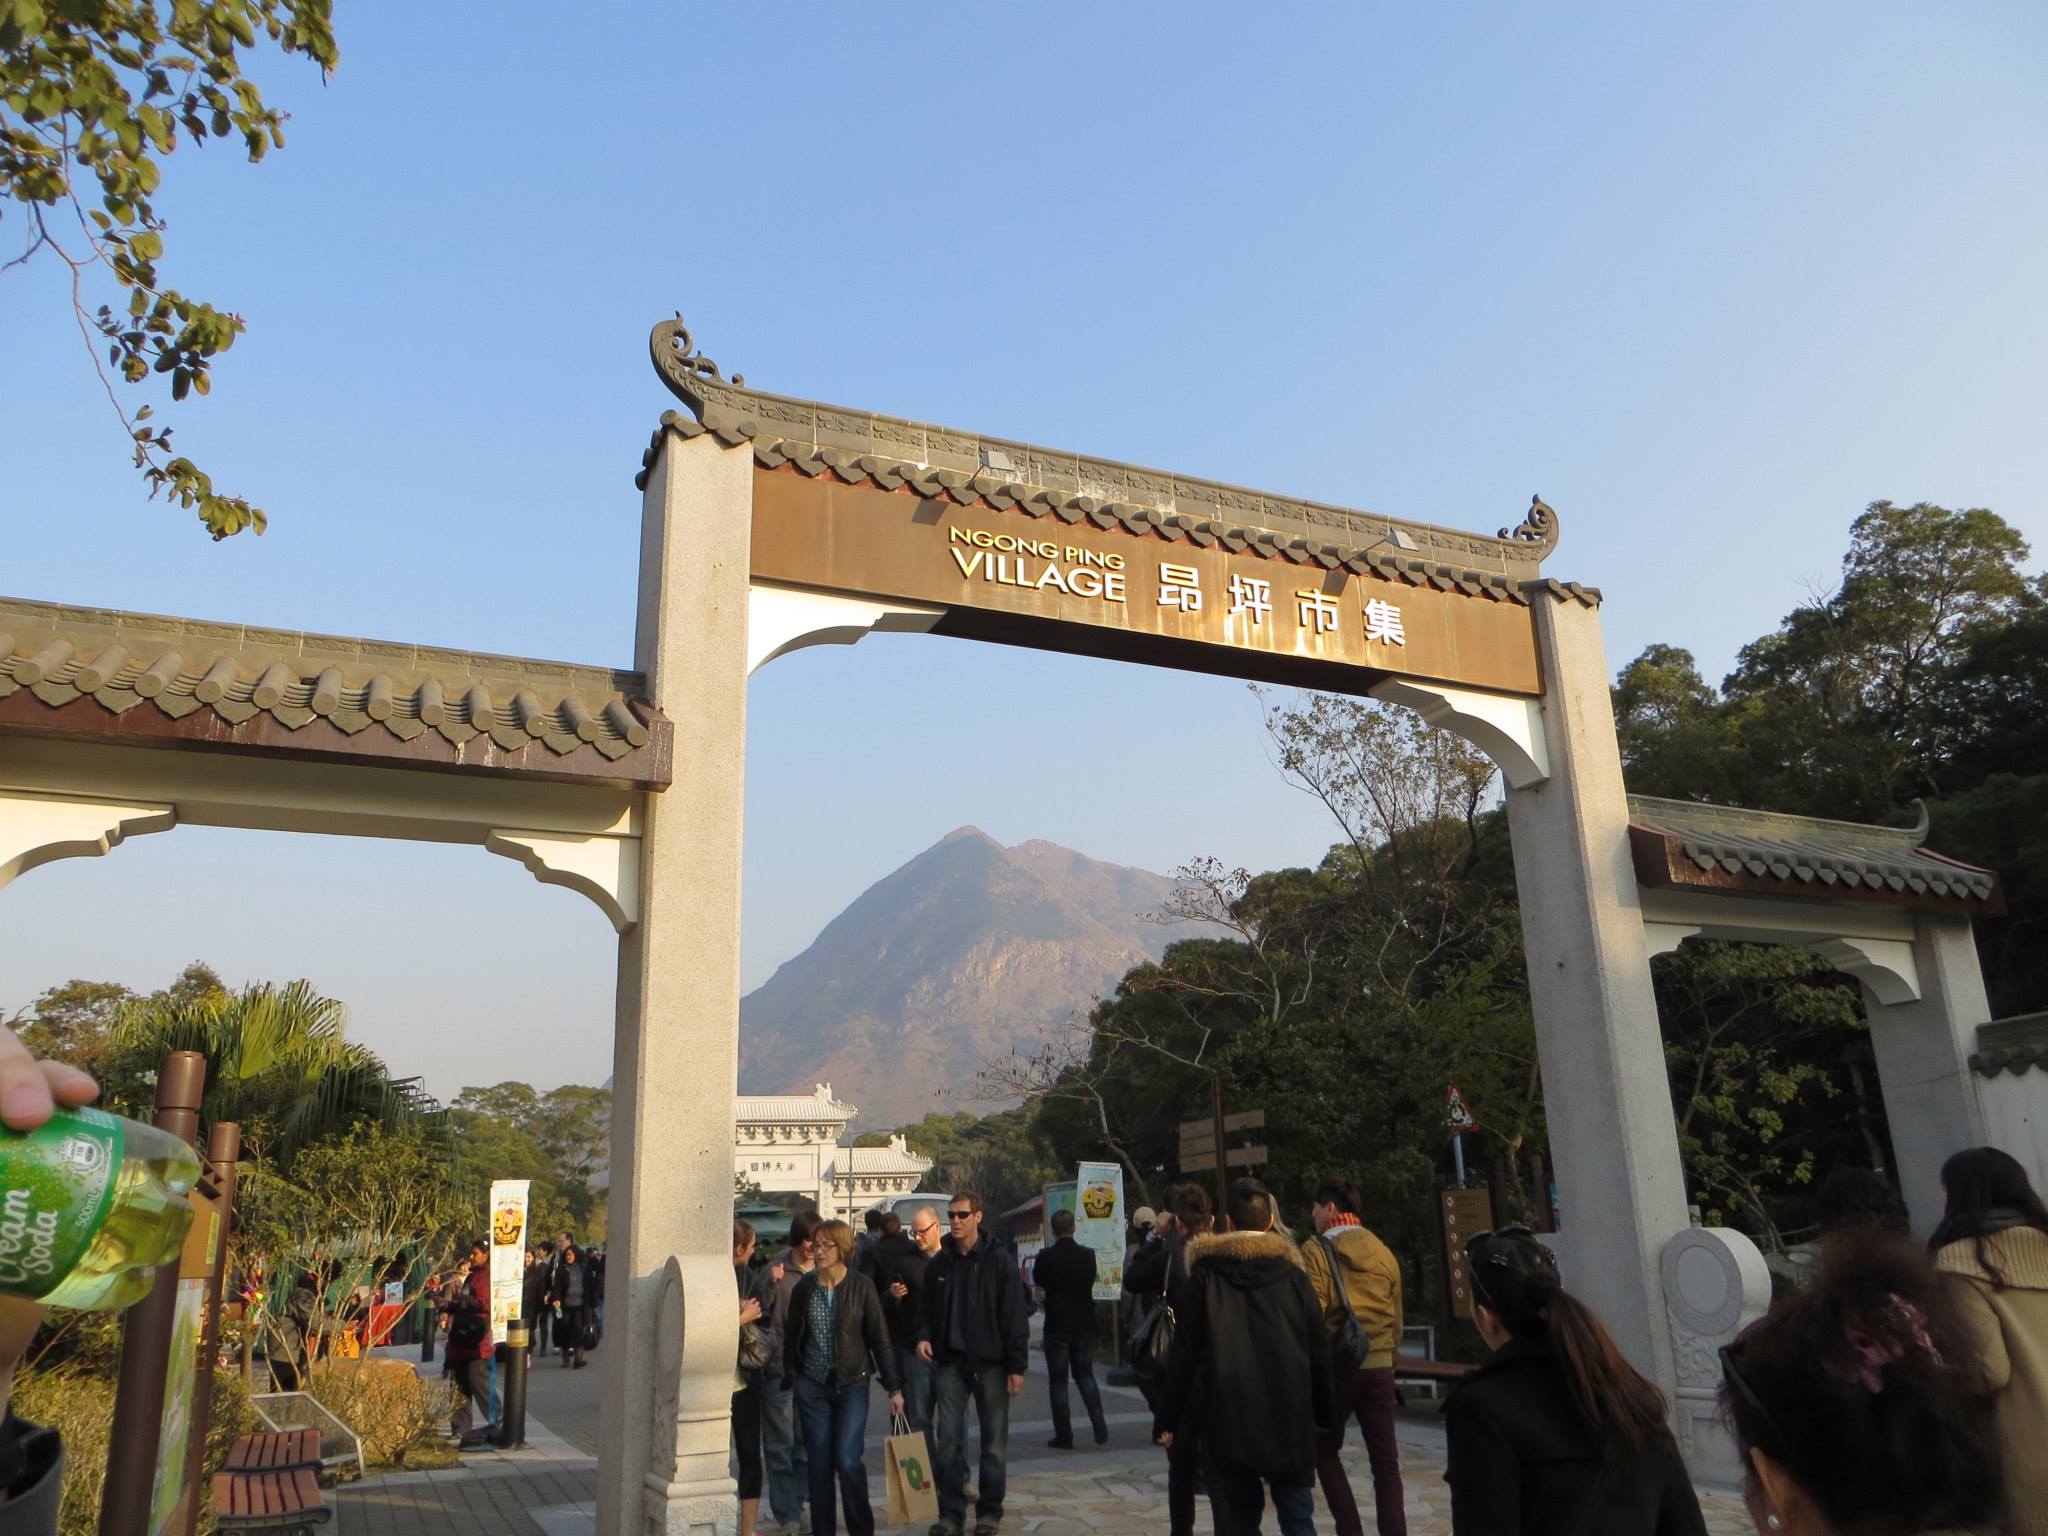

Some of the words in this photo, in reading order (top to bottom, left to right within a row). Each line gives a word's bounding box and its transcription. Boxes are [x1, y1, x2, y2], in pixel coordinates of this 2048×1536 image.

[950, 525, 1059, 559] NGONG
[1064, 546, 1126, 570] PING
[951, 547, 1127, 603] VILLAGE
[1157, 562, 1406, 646] 昂坪市集
[21, 1210, 58, 1275] Soda
